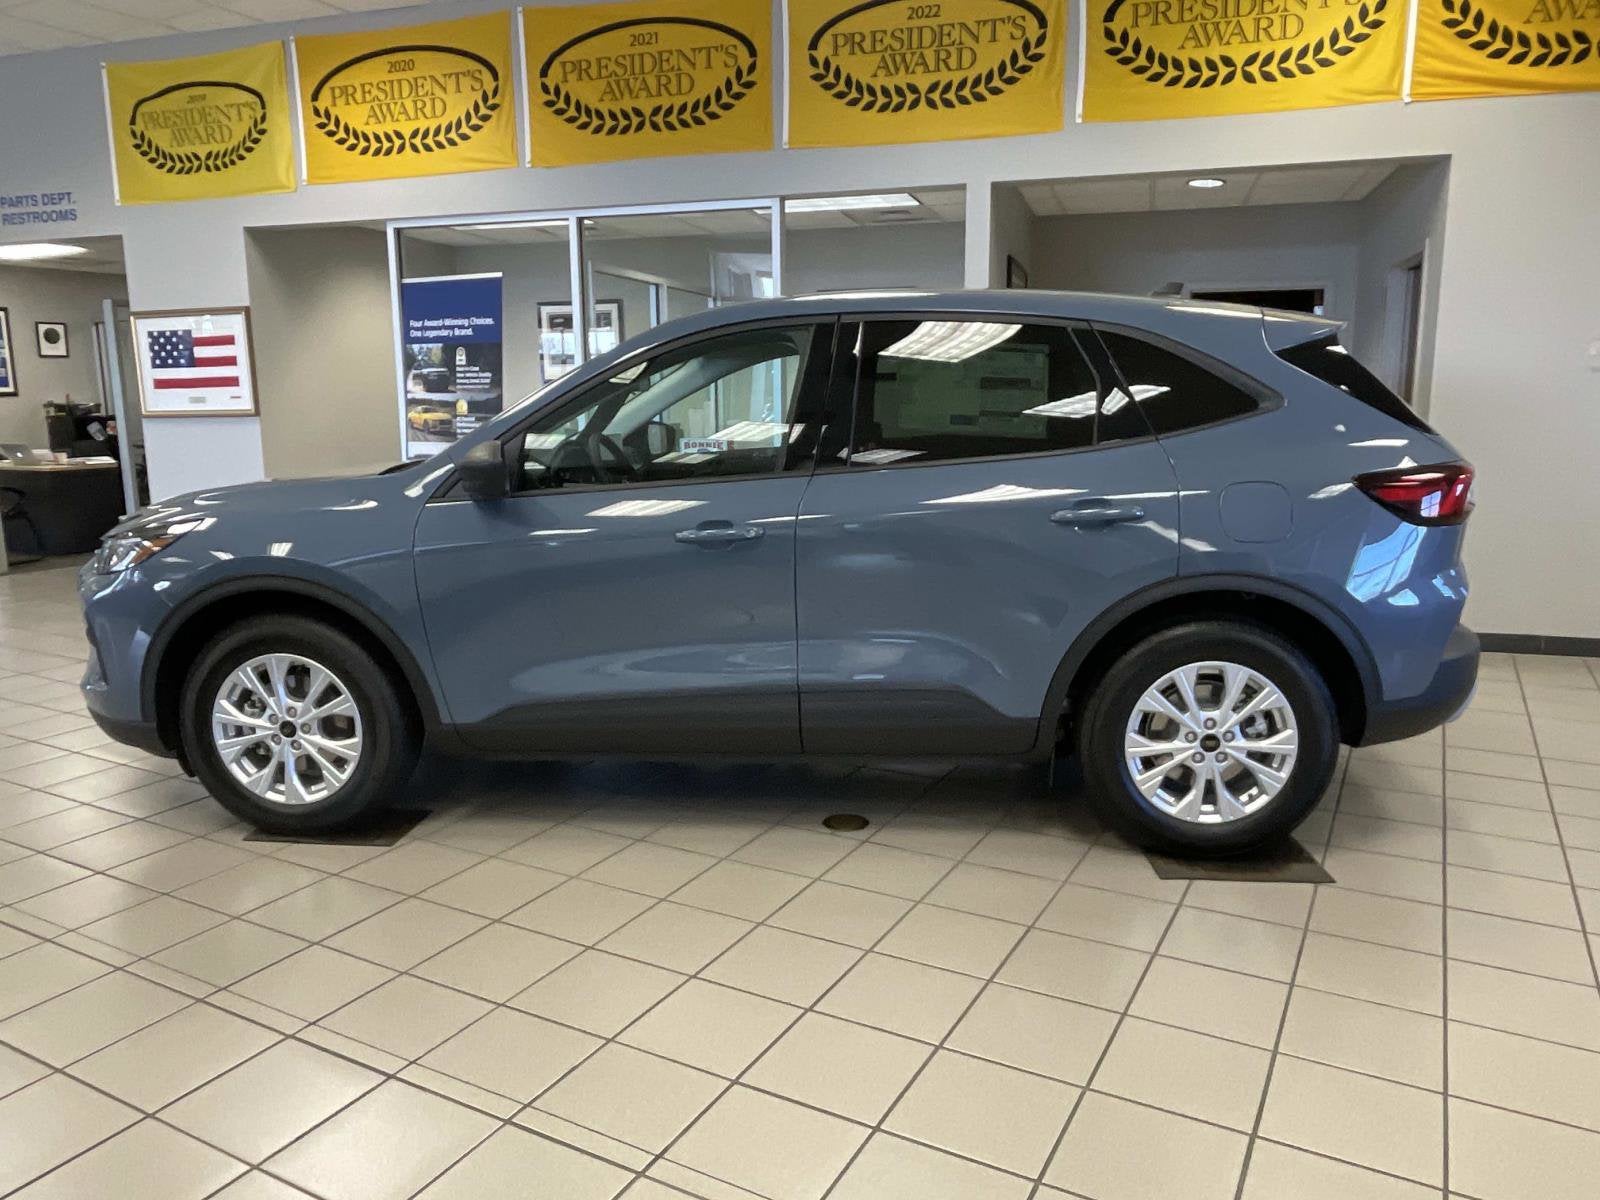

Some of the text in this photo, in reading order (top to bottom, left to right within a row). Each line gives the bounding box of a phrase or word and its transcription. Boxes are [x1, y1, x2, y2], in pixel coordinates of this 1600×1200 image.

[907, 4, 941, 20] 2022
[1131, 0, 1361, 28] PRESIDE
[630, 32, 659, 47] 2021
[831, 15, 1026, 57] PRESIDENT'S
[1178, 13, 1304, 49] AWARD
[387, 59, 415, 73] 2020
[560, 44, 739, 83] PRESIDENT'S
[871, 47, 977, 77] AWARD
[329, 69, 485, 107] PRESIDENT'S
[599, 72, 695, 102] AWARD
[141, 101, 258, 130] PRESIDENT'S
[365, 97, 447, 125] AWARD
[169, 124, 233, 148] AWARD
[0, 192, 77, 208] PARTS DEPT.
[2, 208, 77, 225] RESTROOMS
